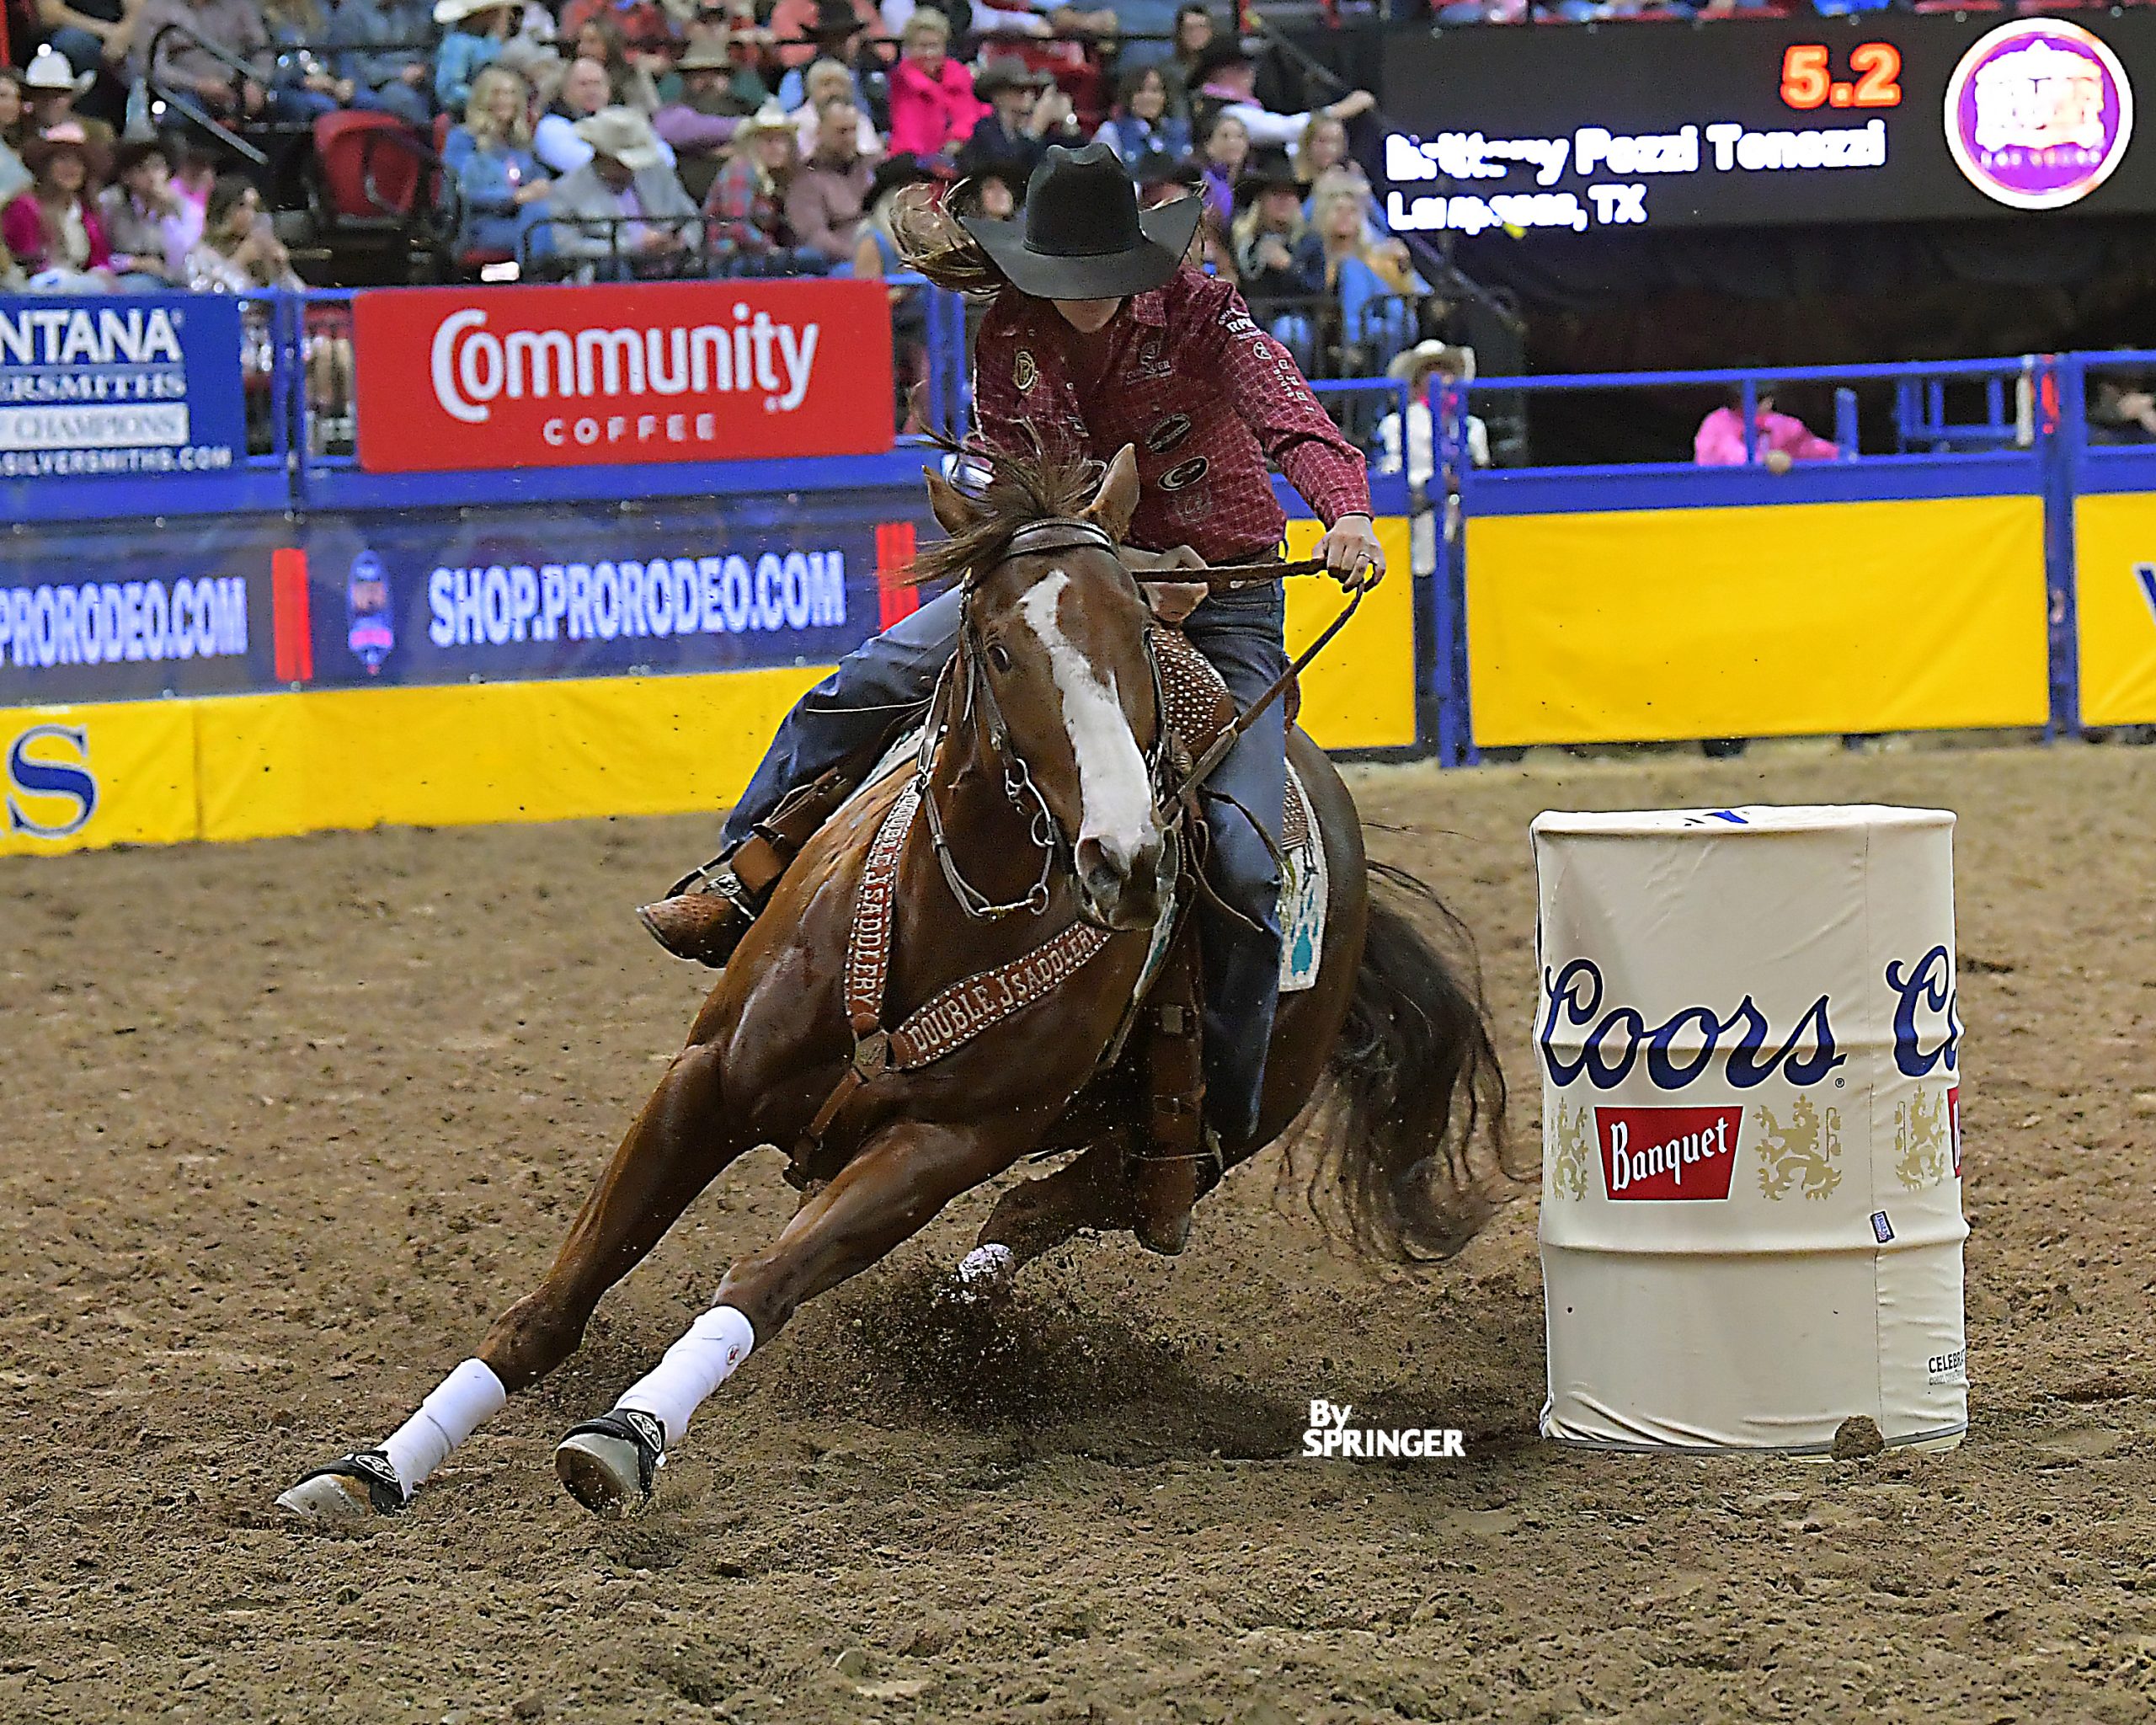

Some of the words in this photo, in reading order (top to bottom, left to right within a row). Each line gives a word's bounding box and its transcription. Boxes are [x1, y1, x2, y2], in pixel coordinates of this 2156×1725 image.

[1781, 43, 1902, 109] 5.2
[1588, 184, 1647, 225] TX
[430, 302, 820, 423] Community
[543, 413, 715, 446] COFFEE
[429, 550, 846, 648] SHOP.PRORODEO.COM
[908, 985, 997, 1053] DOUBLE
[1013, 927, 1098, 999] SADDLERY
[1545, 958, 1848, 1090] Coors
[1609, 1117, 1730, 1192] Banquet
